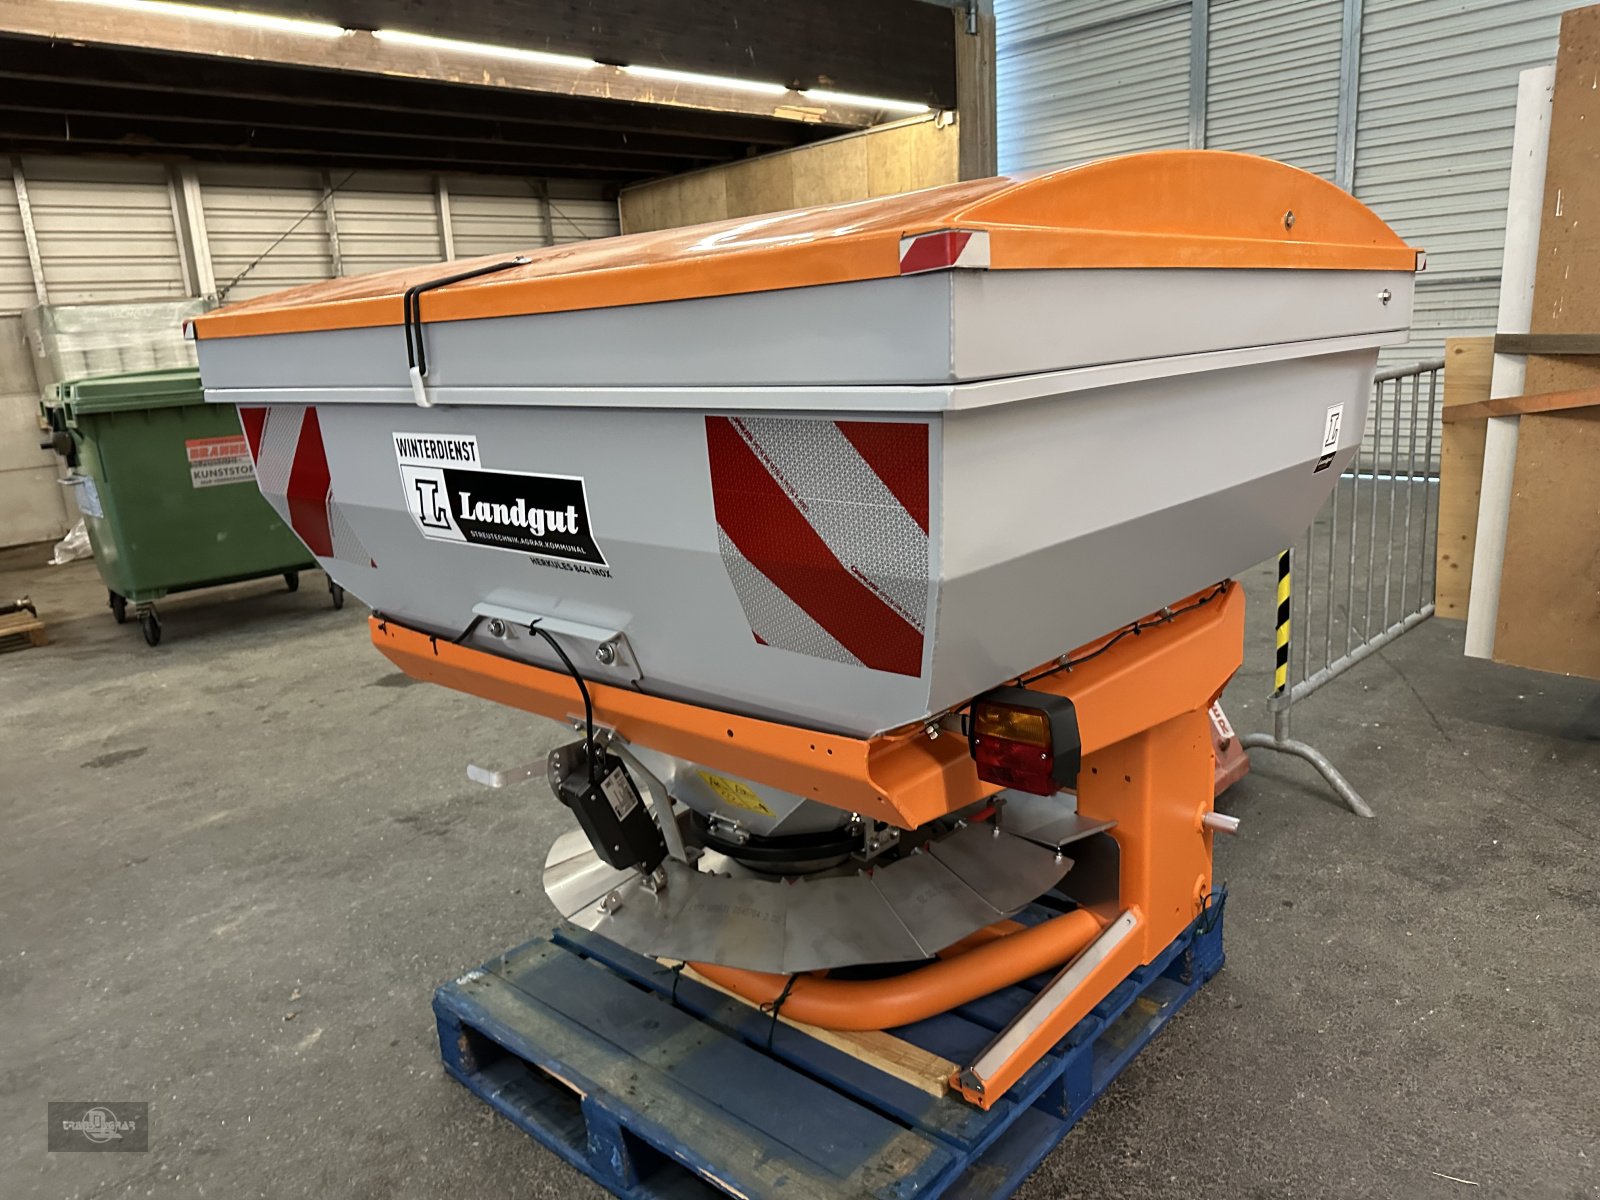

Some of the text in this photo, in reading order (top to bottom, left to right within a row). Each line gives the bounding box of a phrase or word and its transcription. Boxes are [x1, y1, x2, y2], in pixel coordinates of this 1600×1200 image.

[396, 437, 476, 462] WINTERDIENST
[415, 478, 452, 530] L
[458, 491, 579, 537] Landgut
[529, 556, 573, 572] HERKULES
[590, 567, 613, 579] INOX
